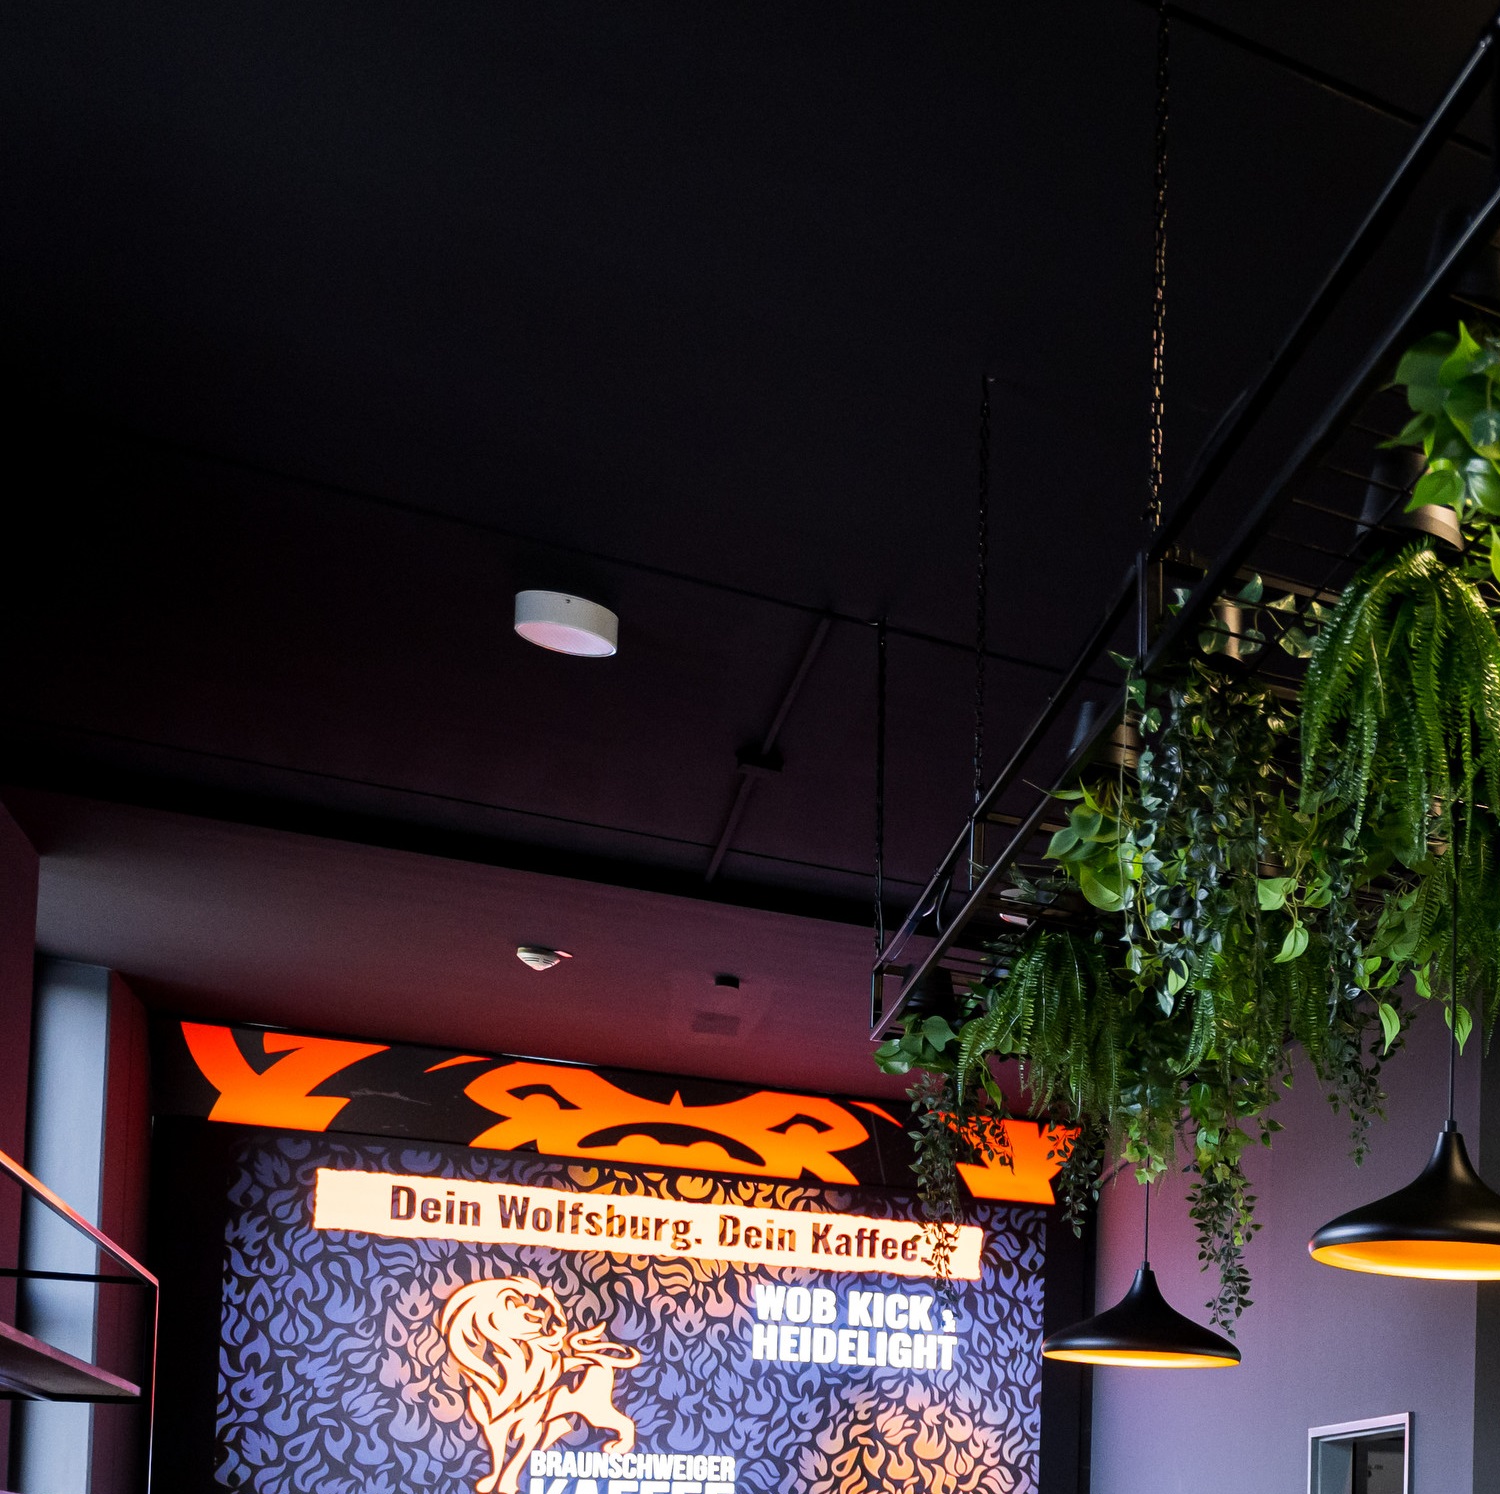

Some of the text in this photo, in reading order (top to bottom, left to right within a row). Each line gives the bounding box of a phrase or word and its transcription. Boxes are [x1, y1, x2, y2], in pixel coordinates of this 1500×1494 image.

[390, 1185, 482, 1227] Dein
[498, 1194, 702, 1250] Wolfsburg.
[718, 1214, 796, 1252] Dein
[755, 1284, 837, 1325] WOB
[849, 1291, 933, 1332] KICK
[752, 1324, 957, 1371] HEIDELIGHT
[530, 1450, 736, 1482] BRAUNSCHWEIGER
